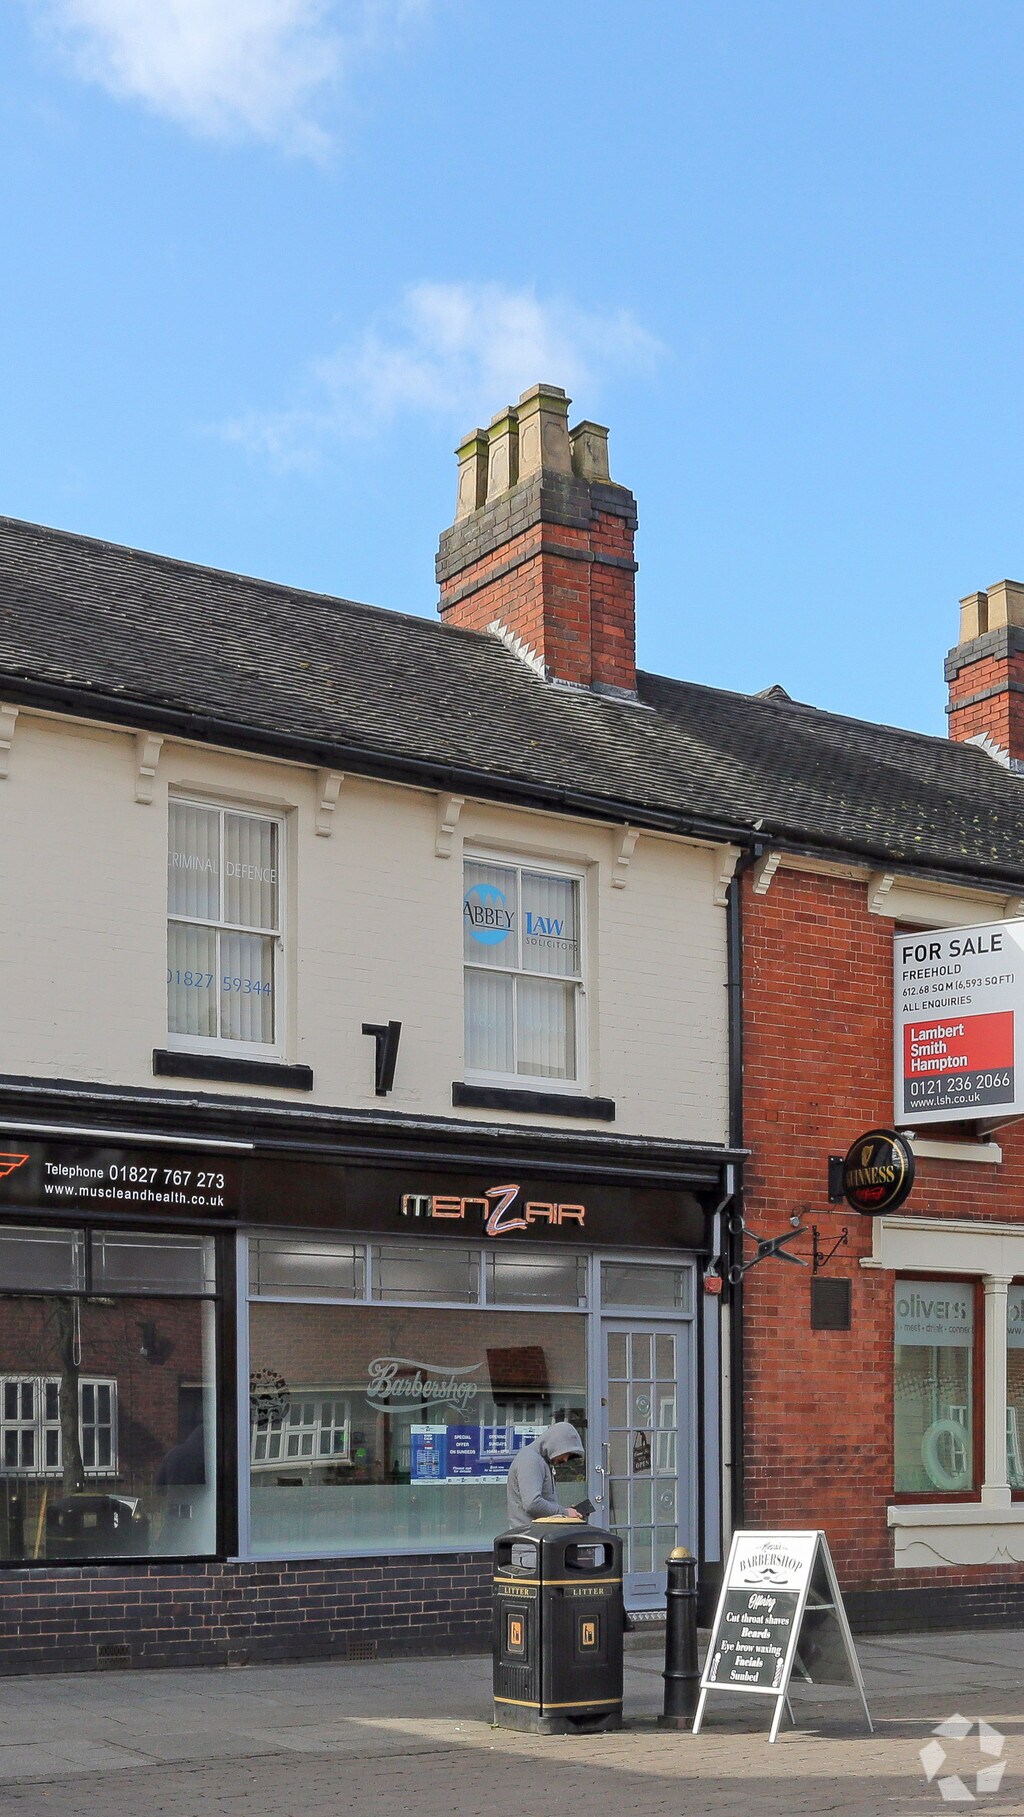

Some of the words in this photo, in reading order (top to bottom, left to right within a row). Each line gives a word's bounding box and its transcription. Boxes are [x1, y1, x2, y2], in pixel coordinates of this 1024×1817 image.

[226, 861, 277, 884] DEFENCE
[463, 900, 515, 928] ABBEY
[525, 911, 564, 936] LAW
[526, 937, 578, 952] SOLICITORS
[902, 942, 942, 965] FOR
[949, 933, 1003, 958] SALE
[902, 964, 962, 981] FREEHOLD
[223, 976, 272, 996] 59344
[902, 985, 929, 997] 612.68
[932, 983, 944, 993] SQ
[945, 982, 953, 991] M
[955, 978, 982, 990] (6,593
[985, 976, 998, 986] SQ
[999, 973, 1015, 984] FT)
[902, 1003, 920, 1012] ALL
[922, 995, 972, 1010] ENQUIRIES
[911, 1023, 965, 1042] Lambert
[910, 1040, 947, 1057] Smith
[911, 1055, 968, 1072] Hampton
[910, 1079, 942, 1096] 0121
[947, 1076, 972, 1092] 236
[976, 1072, 1010, 1089] 2066
[910, 1092, 980, 1108] www.lsh.co.uk
[45, 1162, 104, 1179] Telephone
[109, 1164, 158, 1184] 01827
[163, 1169, 192, 1186] 767
[196, 1172, 225, 1189] 273
[44, 1183, 224, 1207] www.muscleandhealth.co.uk
[897, 1293, 966, 1319] olivers
[367, 1359, 478, 1408] Barbershop
[740, 1553, 803, 1572] BARBERSHOP
[504, 1587, 530, 1596] LITTER
[573, 1587, 604, 1596] LITTER
[726, 1611, 740, 1623] Cut
[741, 1612, 764, 1624] throat
[765, 1614, 790, 1626] shaves
[741, 1627, 771, 1639] Beards
[720, 1640, 735, 1654] Eye
[735, 1640, 754, 1652] brow
[756, 1643, 782, 1658] waxing
[734, 1655, 764, 1667] Facials
[730, 1669, 759, 1682] Sunbed
